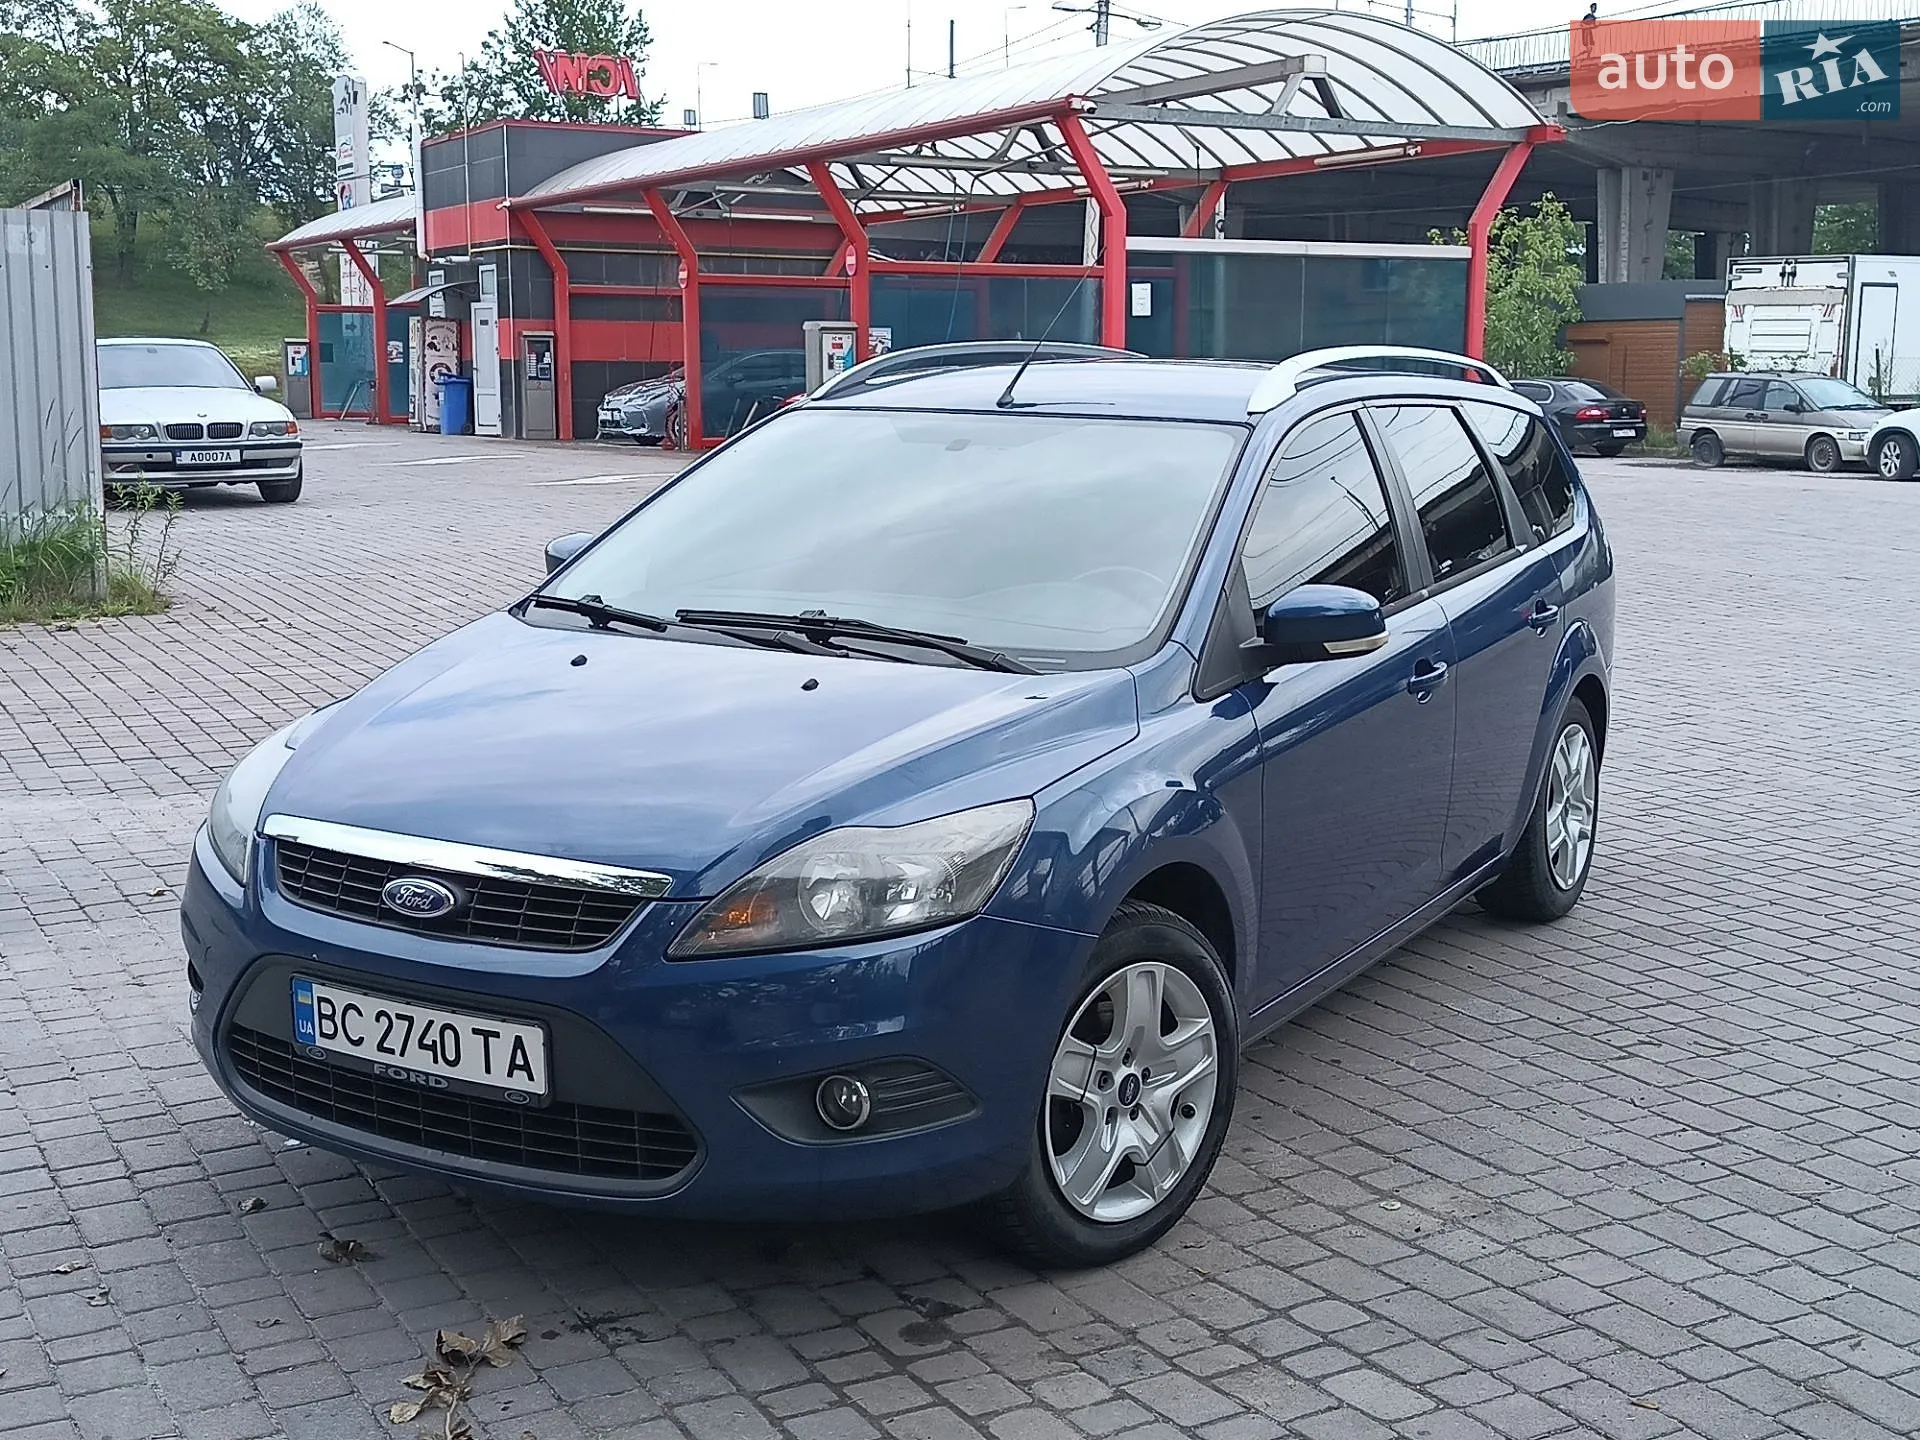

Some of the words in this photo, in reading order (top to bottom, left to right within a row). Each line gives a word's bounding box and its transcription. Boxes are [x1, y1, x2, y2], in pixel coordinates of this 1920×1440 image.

[395, 885, 434, 910] Ford
[299, 1019, 314, 1036] UA
[316, 995, 365, 1047] BC
[374, 1009, 462, 1068] 2740
[471, 1027, 535, 1082] TA
[373, 1062, 449, 1088] FORD
